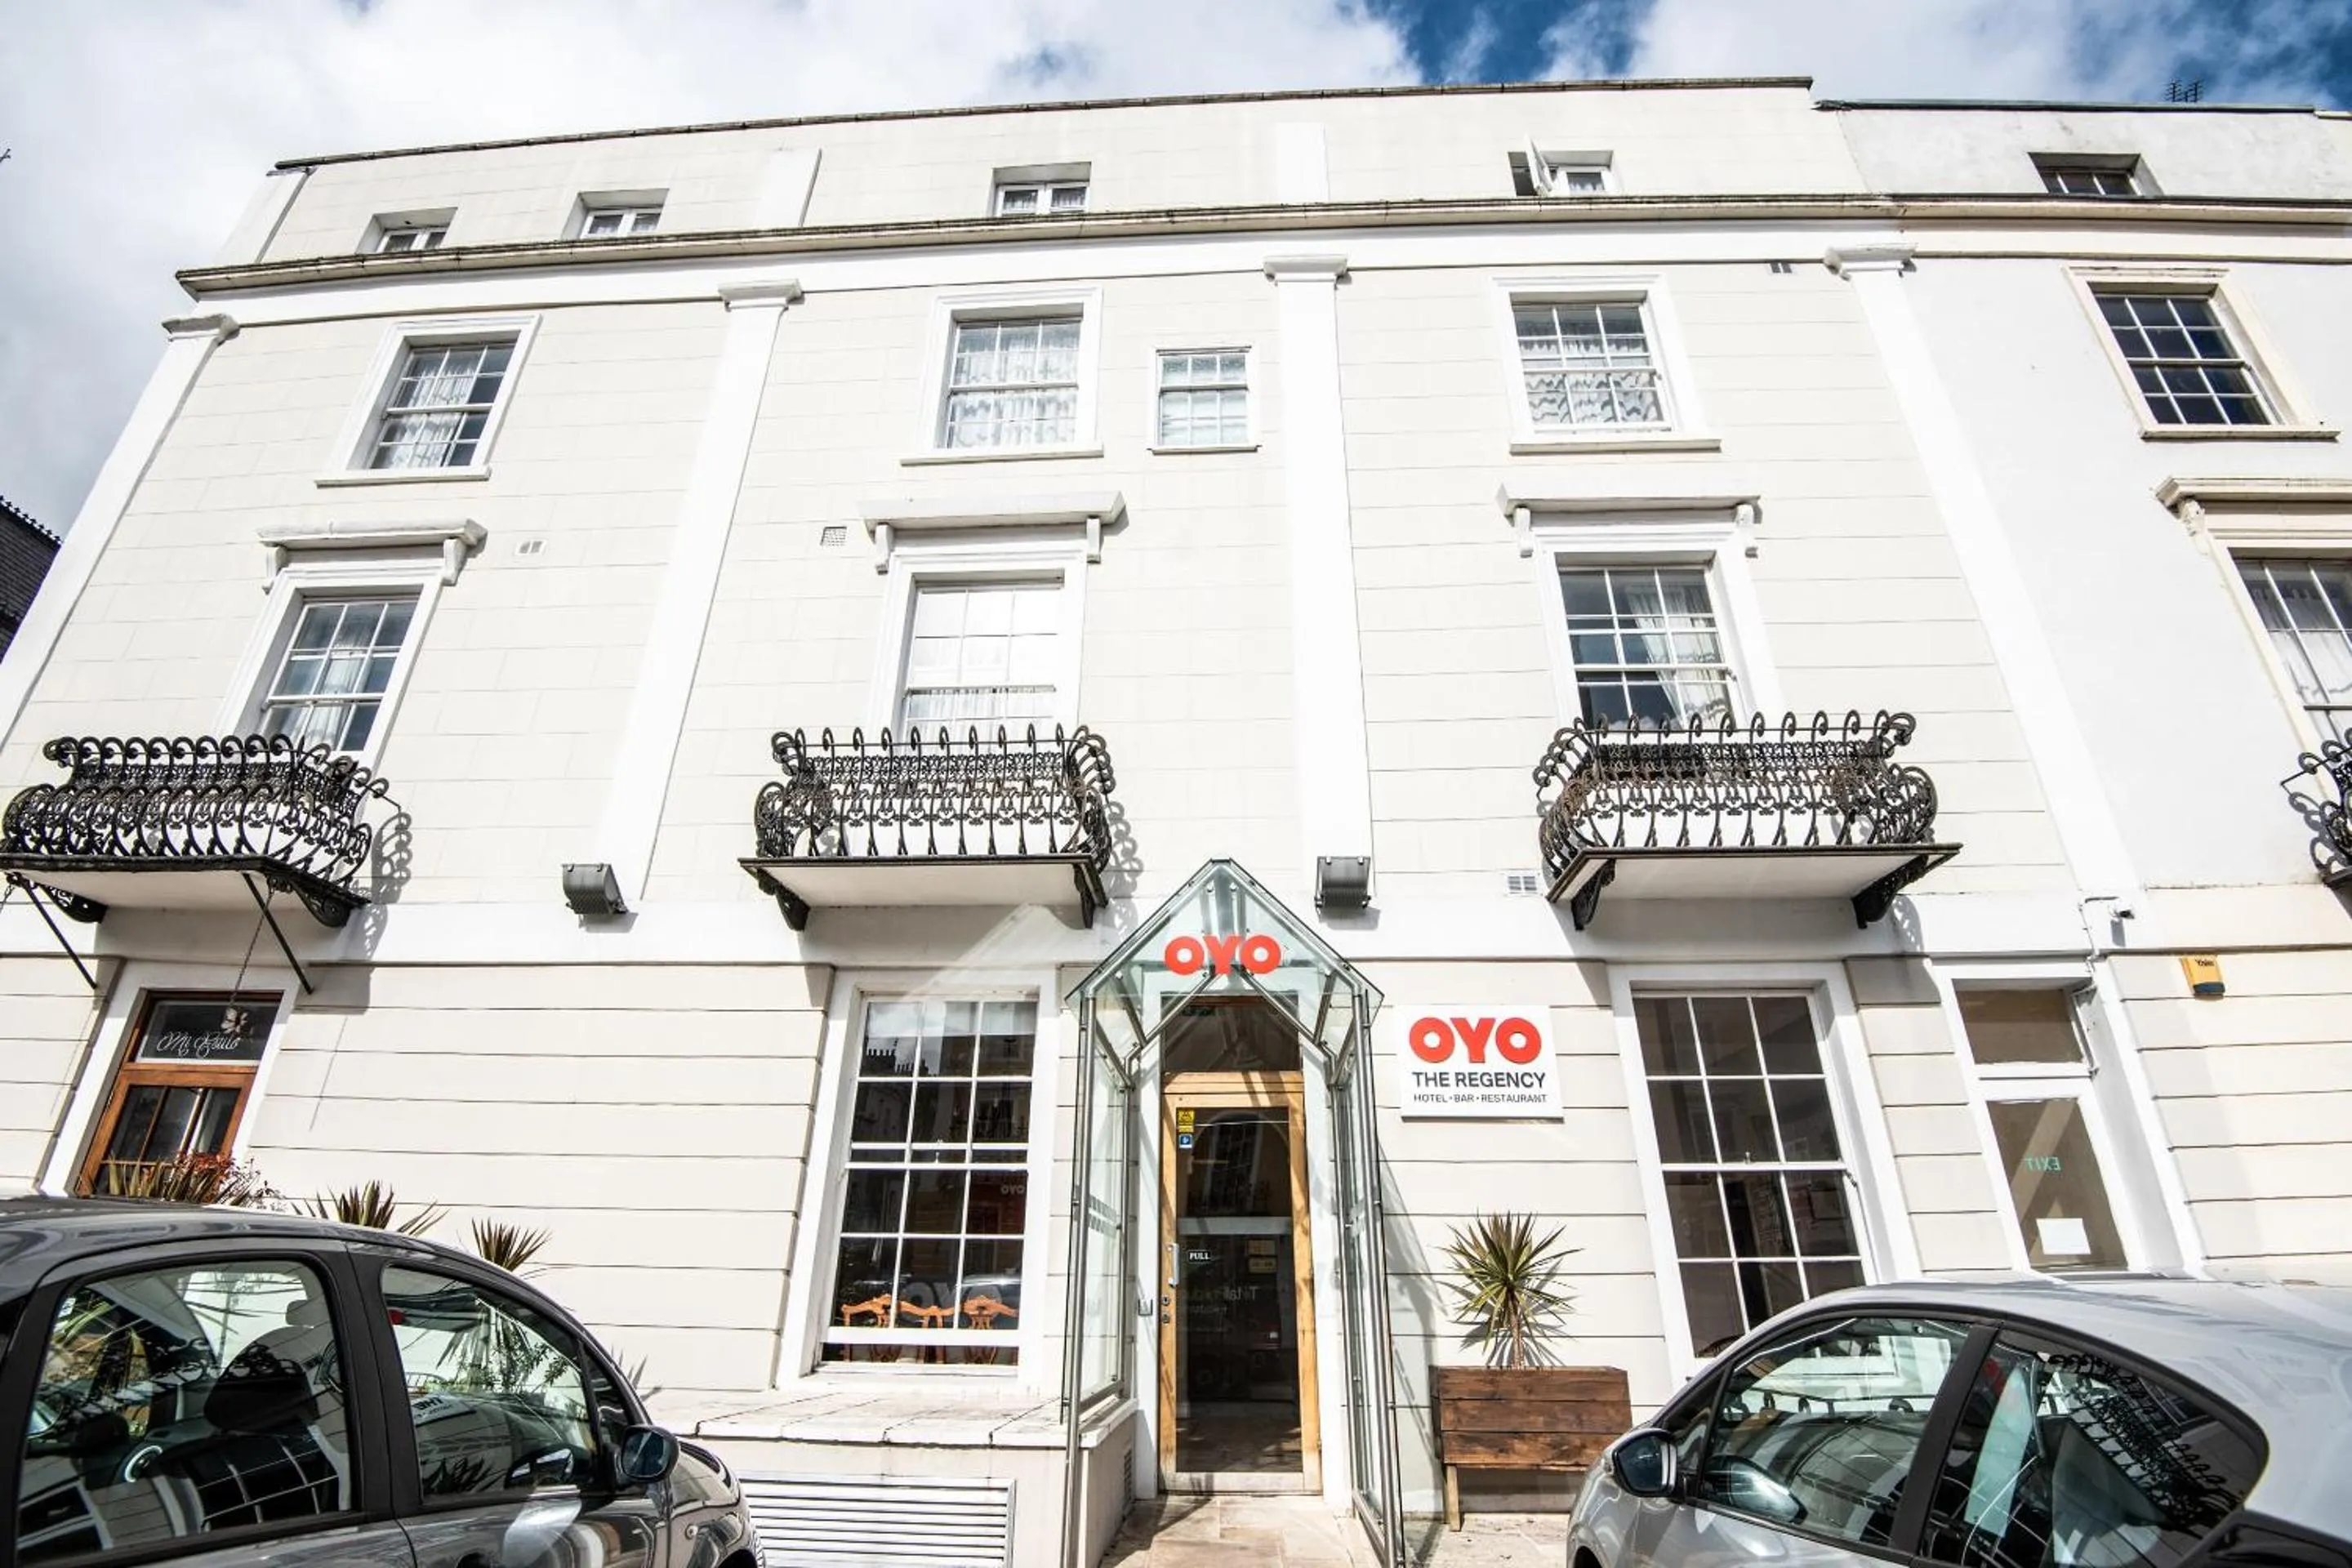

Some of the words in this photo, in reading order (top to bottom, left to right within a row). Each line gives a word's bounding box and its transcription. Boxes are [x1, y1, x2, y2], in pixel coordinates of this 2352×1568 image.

[1165, 935, 1281, 976] OYO
[1409, 1018, 1542, 1065] OYO
[1412, 1071, 1450, 1088] THE
[1455, 1071, 1546, 1089] REGENCY
[1414, 1094, 1450, 1102] HOTEL
[1454, 1094, 1474, 1102] BAR
[1481, 1094, 1548, 1103] RESTAURANT
[1189, 1252, 1209, 1260] PULL
